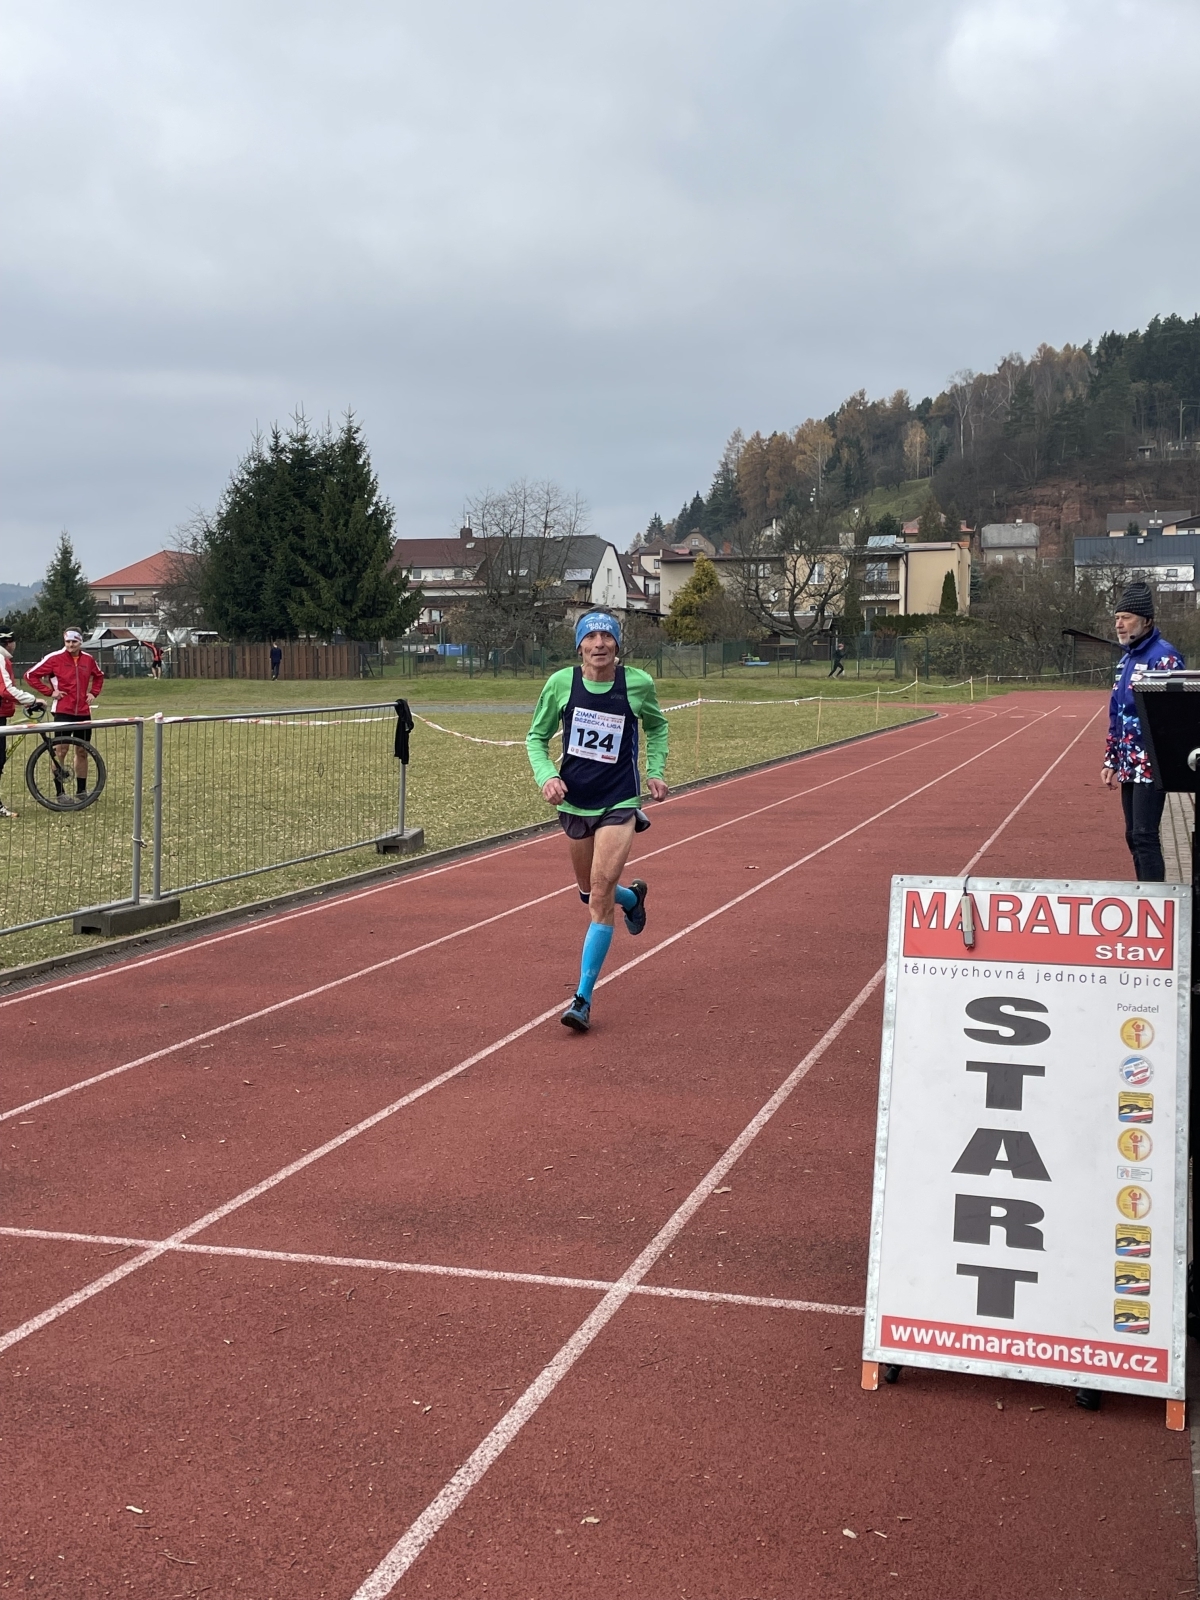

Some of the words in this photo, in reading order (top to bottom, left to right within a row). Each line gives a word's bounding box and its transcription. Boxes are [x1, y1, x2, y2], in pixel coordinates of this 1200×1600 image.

[575, 711, 598, 720] ZIMNÍ
[577, 728, 615, 753] 124
[905, 890, 1175, 938] MARATON
[1095, 942, 1166, 962] stav
[904, 962, 1026, 981] tělovýchovná
[1035, 969, 1108, 985] jednota
[1119, 971, 1174, 989] Úpice
[1116, 1003, 1160, 1013] Pořadatel
[951, 996, 1052, 1320] START
[890, 1324, 1158, 1374] www.maratonstav.cz
